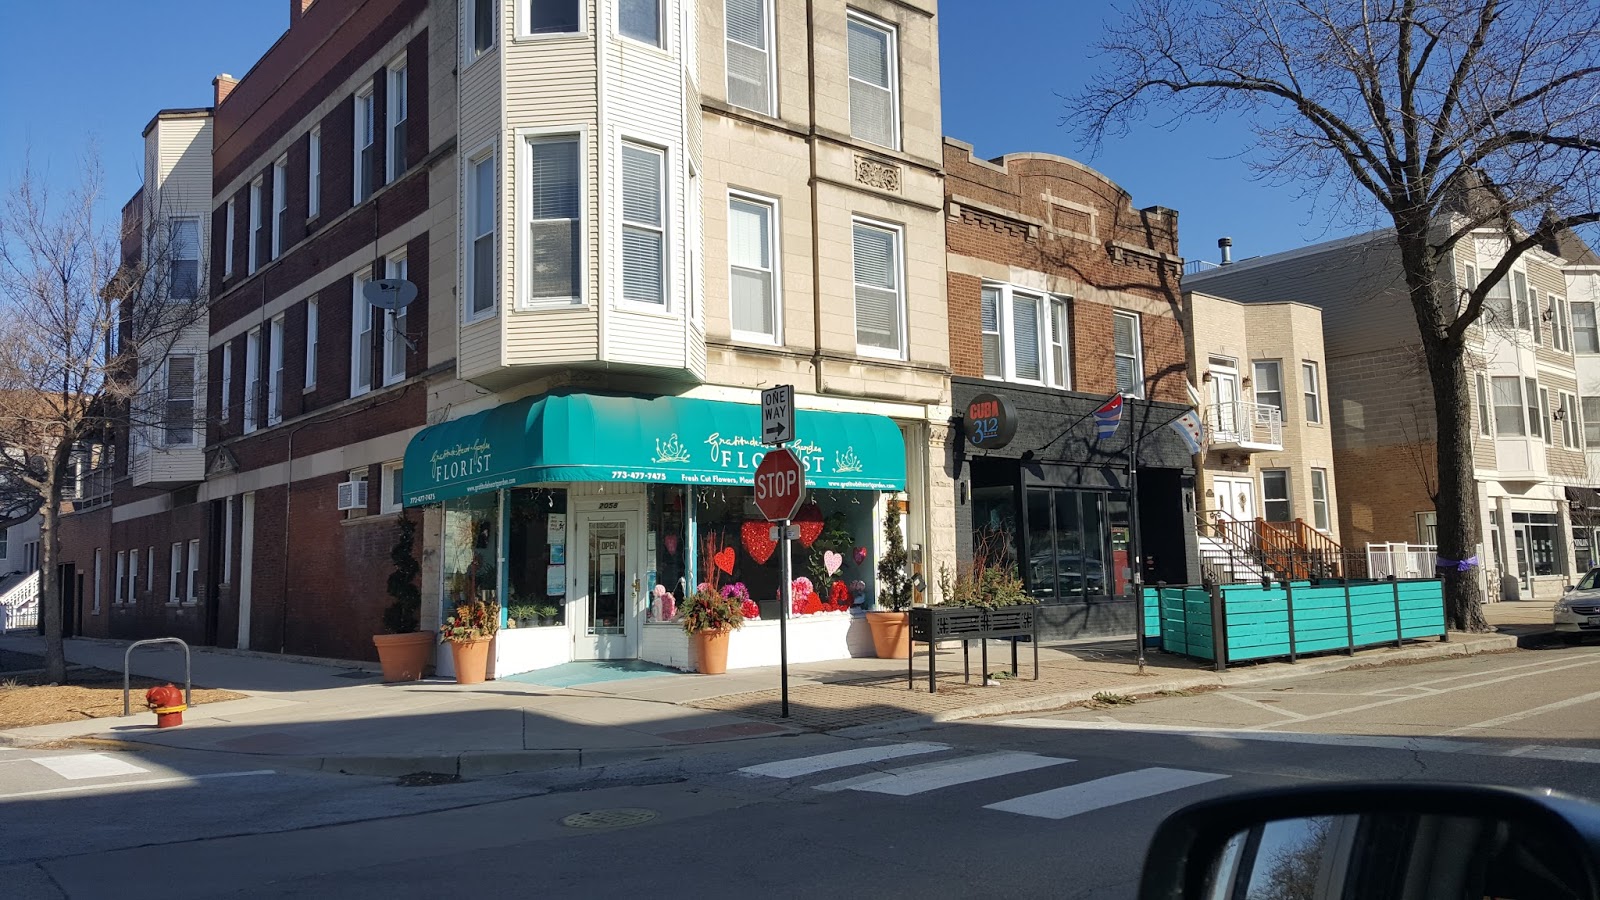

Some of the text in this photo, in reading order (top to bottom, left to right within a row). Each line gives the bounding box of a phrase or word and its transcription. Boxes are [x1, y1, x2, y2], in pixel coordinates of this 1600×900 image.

[765, 390, 786, 406] ONE
[765, 405, 787, 421] WAY
[970, 400, 999, 420] CUBA
[971, 417, 999, 444] 312
[435, 453, 492, 482] FLORIST
[611, 471, 667, 481] 773-477-7475
[681, 474, 699, 482] Fresh
[700, 475, 712, 483] Cut
[757, 469, 797, 500] STOP
[601, 541, 618, 550] OPEN
